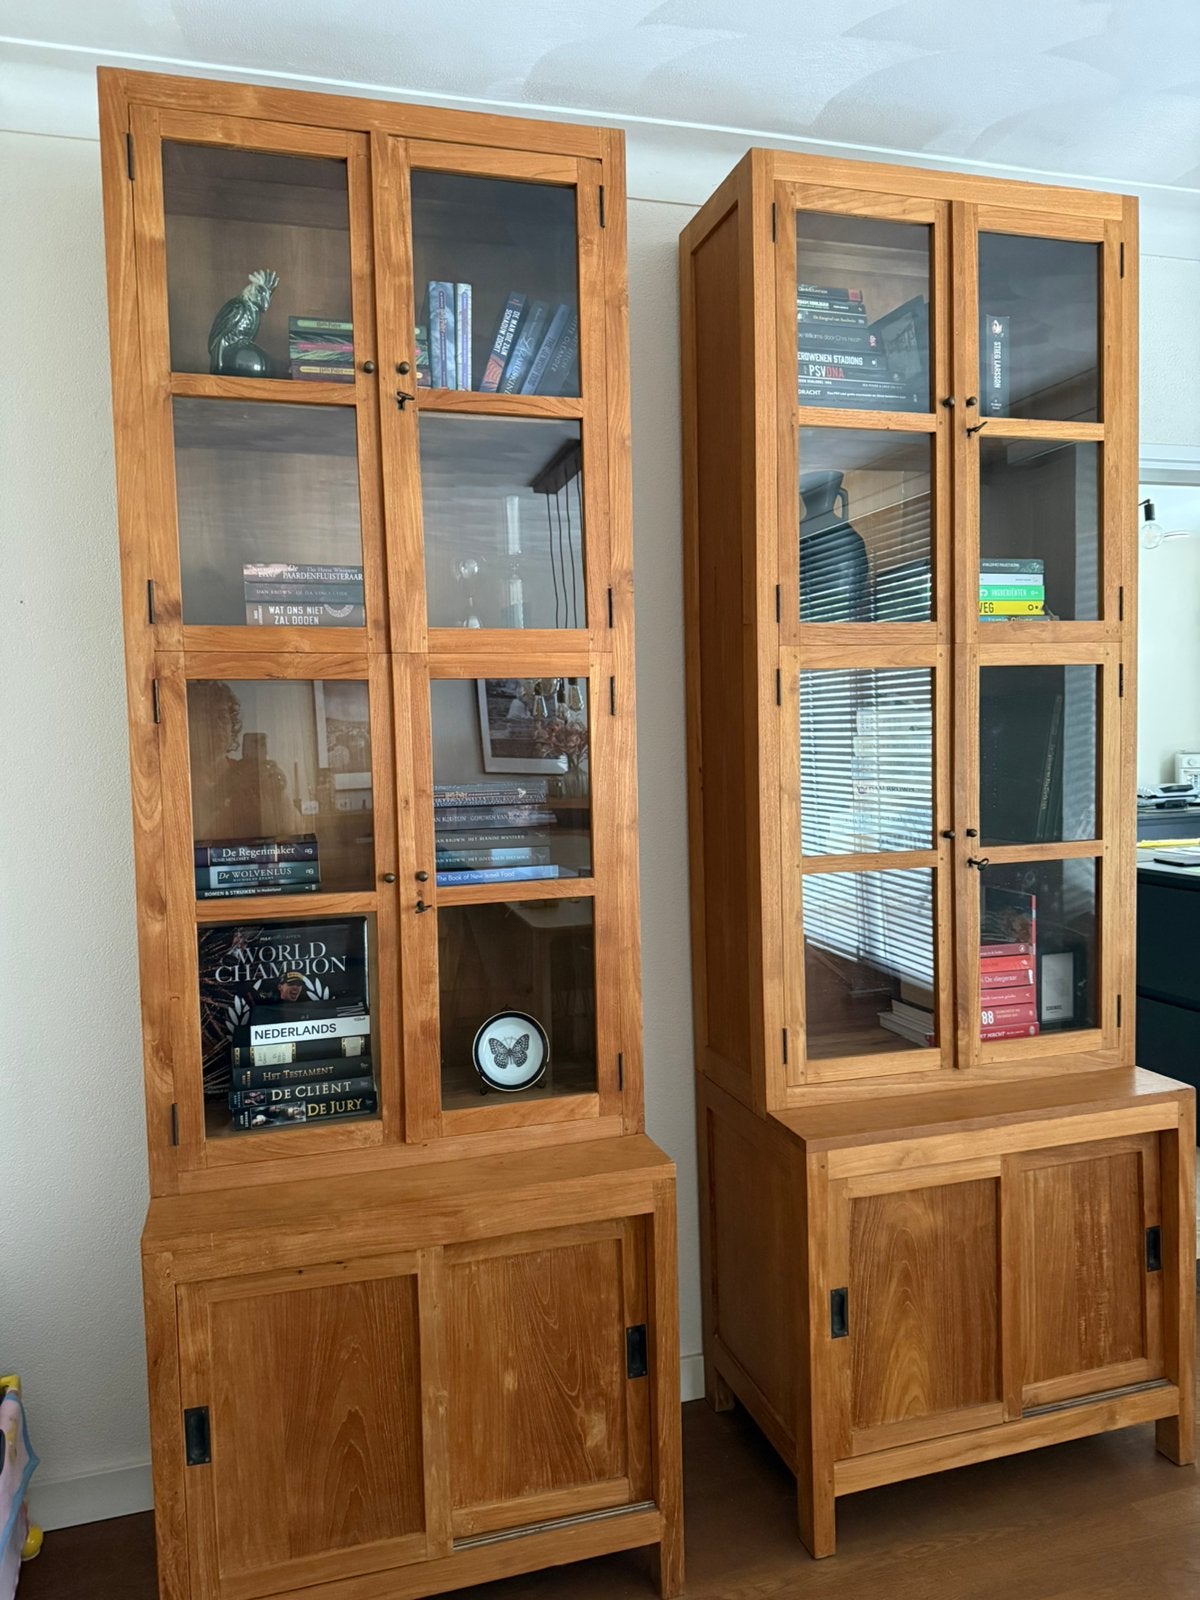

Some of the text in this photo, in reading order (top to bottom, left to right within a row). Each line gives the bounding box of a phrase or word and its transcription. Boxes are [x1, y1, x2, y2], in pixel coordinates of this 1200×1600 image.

[512, 311, 520, 319] DE
[508, 319, 518, 333] MAN
[504, 332, 513, 342] DIE
[797, 352, 863, 366] ERDWENEN STADIONS
[798, 388, 821, 396] DRACHT
[282, 571, 363, 580] PAARDENFLUISTERAAR
[269, 606, 283, 615] WAT
[287, 606, 303, 615] ONS
[306, 606, 323, 615] NIET
[274, 616, 319, 625] ZAL DODEN
[222, 846, 295, 858] De Regenmaker
[219, 868, 292, 880] De WOLVENLUS
[501, 870, 515, 878] Food
[237, 941, 326, 964] WORLD
[215, 956, 347, 983] CHAMPION
[981, 1010, 994, 1024] 88
[254, 1023, 337, 1040] NEDERLANDS
